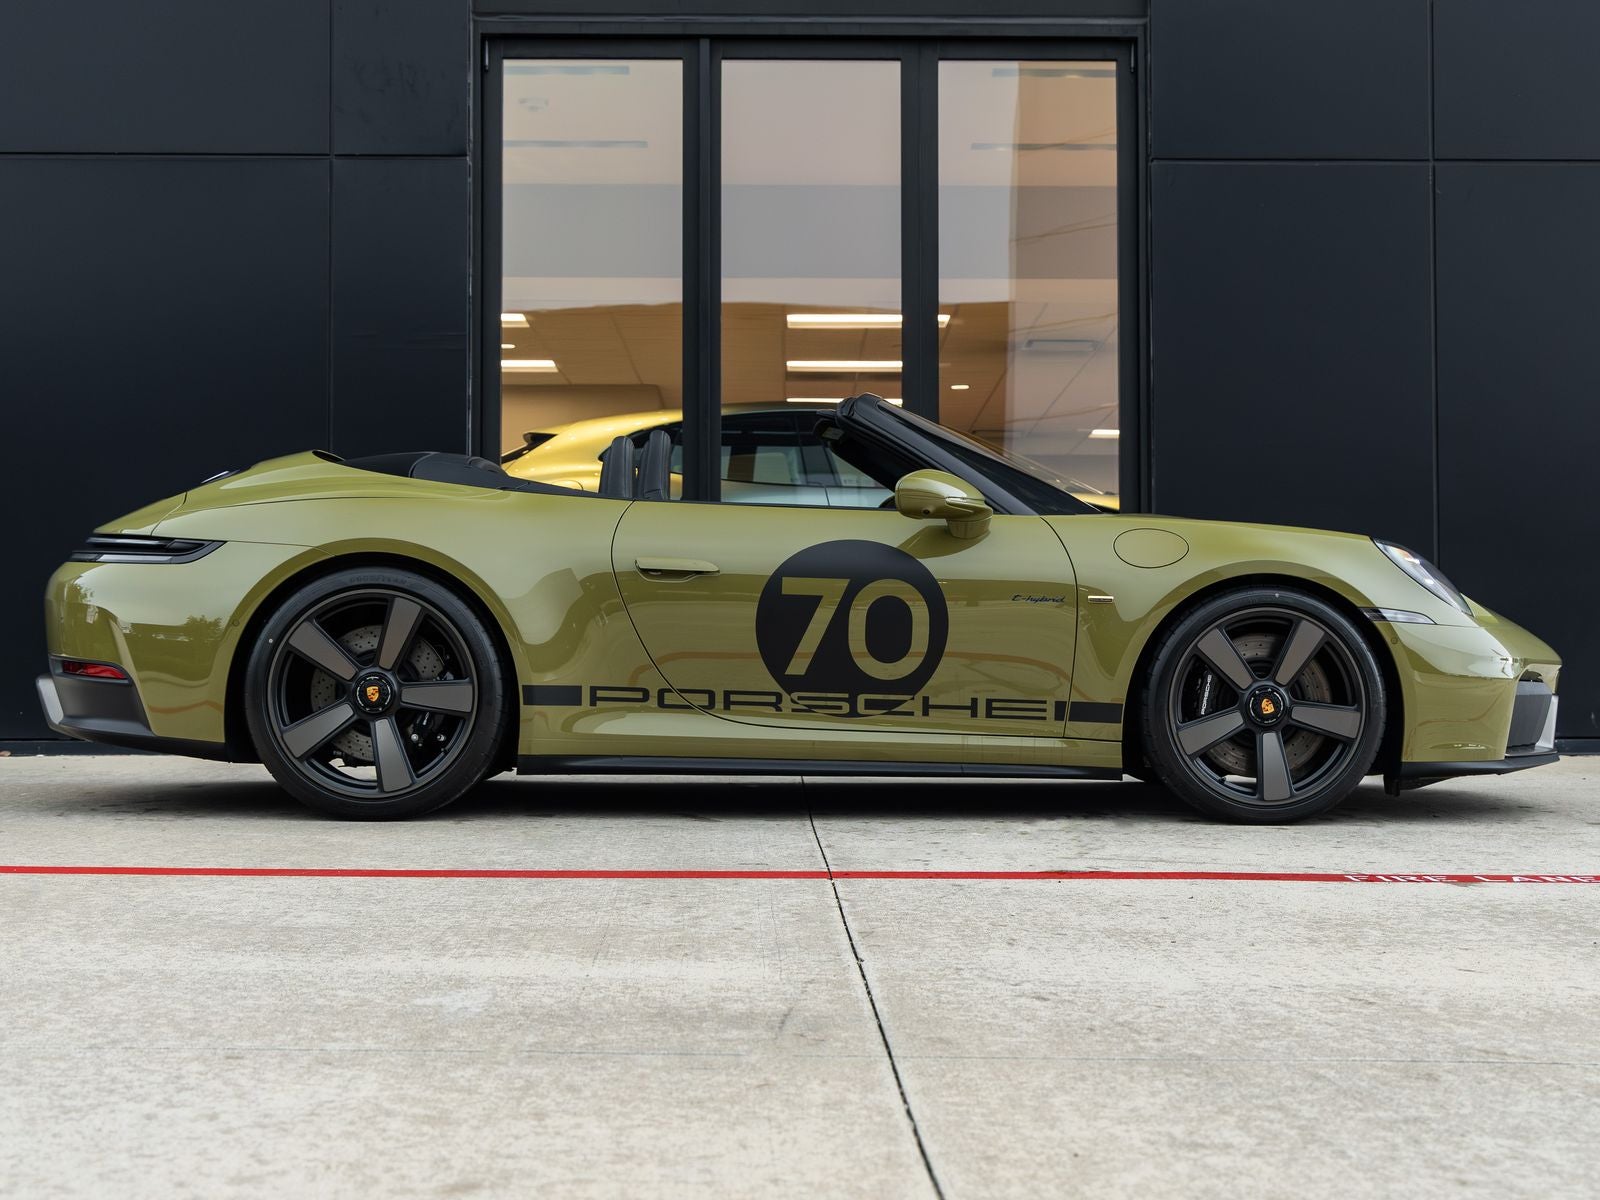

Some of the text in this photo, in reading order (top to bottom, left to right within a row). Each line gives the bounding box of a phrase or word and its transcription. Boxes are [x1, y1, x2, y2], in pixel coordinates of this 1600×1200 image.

[781, 577, 930, 681] 70
[588, 686, 1048, 721] PORSCHE
[1200, 674, 1213, 715] PORSCHE
